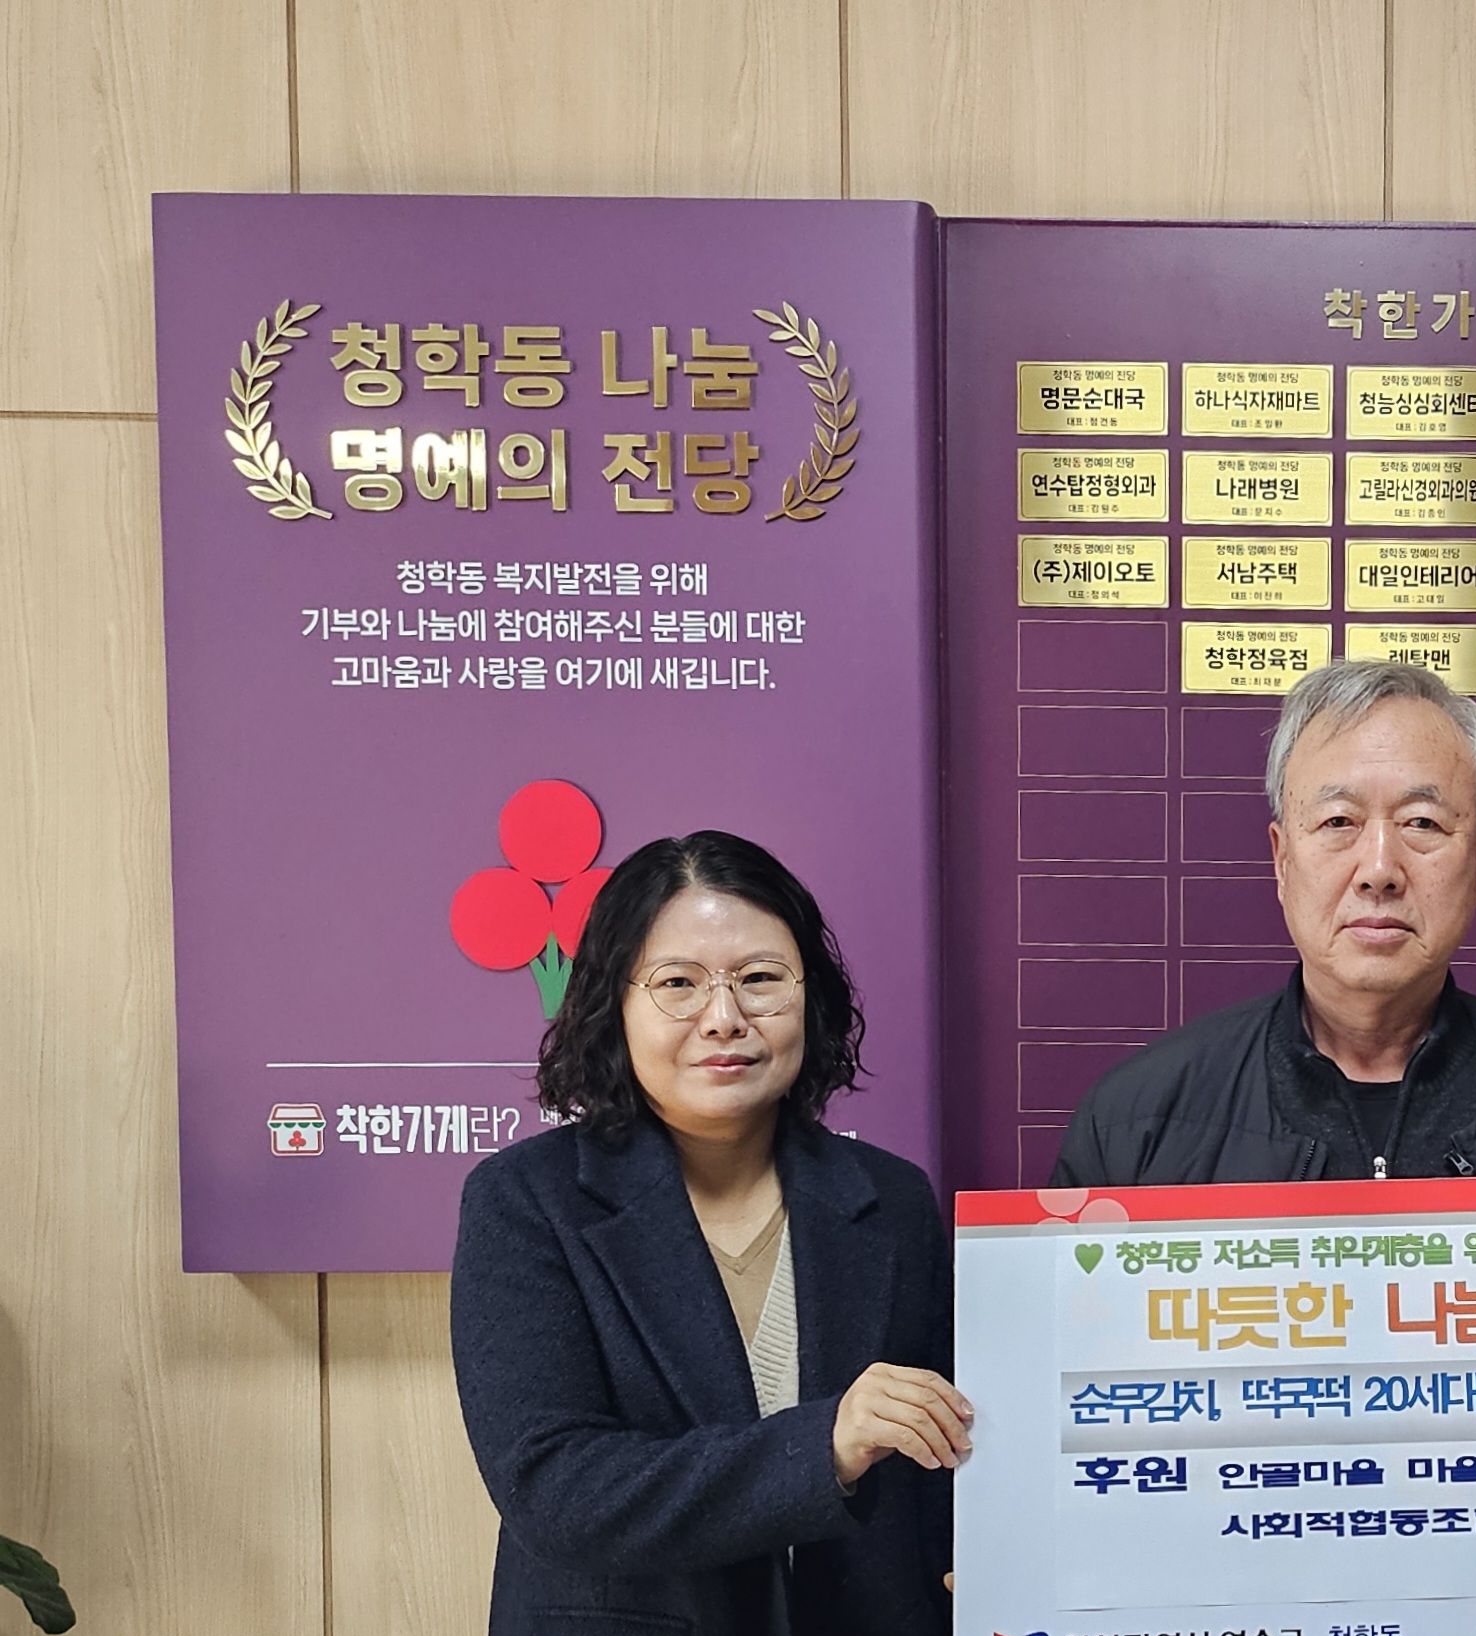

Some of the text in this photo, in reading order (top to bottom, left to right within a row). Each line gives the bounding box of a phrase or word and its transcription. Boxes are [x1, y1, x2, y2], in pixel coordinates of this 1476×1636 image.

[330, 323, 761, 411] 청학동 나눔
[1053, 370, 1135, 381] 청학동 명예의 전당
[1382, 375, 1462, 386] 청학동 명예의 전당
[1040, 387, 1145, 410] 명문순대국
[1195, 390, 1320, 411] 하나식자재마트
[327, 427, 761, 516] 명예의 전당
[1030, 474, 1156, 497] 연수탑정형외과
[1216, 478, 1298, 500] 나래병원
[1053, 544, 1135, 555] 청학동 명예의 전당
[397, 561, 707, 596] 청학동 복지발전을 위해
[1034, 559, 1155, 583] (주)제이오토
[1217, 562, 1297, 584] 서남주택
[302, 608, 806, 643] 기부와 나눔에 참여해주신 분들에 대한
[1217, 631, 1298, 642] 청학동 명예의 전당
[1205, 647, 1307, 670] 청학정육점
[332, 656, 775, 689] 고마움과 사랑을 여기에 새깁니다.
[336, 1104, 522, 1156] 착한가게란?
[1116, 1240, 1201, 1274] 청학동
[1214, 1238, 1301, 1270] 저소득
[1311, 1233, 1452, 1267] 취약계층을
[1148, 1282, 1353, 1351] 따듯한
[1069, 1380, 1222, 1424] 순무김치,
[1242, 1374, 1351, 1418] 떡국떡
[1074, 1457, 1187, 1494] 후원
[1219, 1459, 1384, 1489] 안골마을
